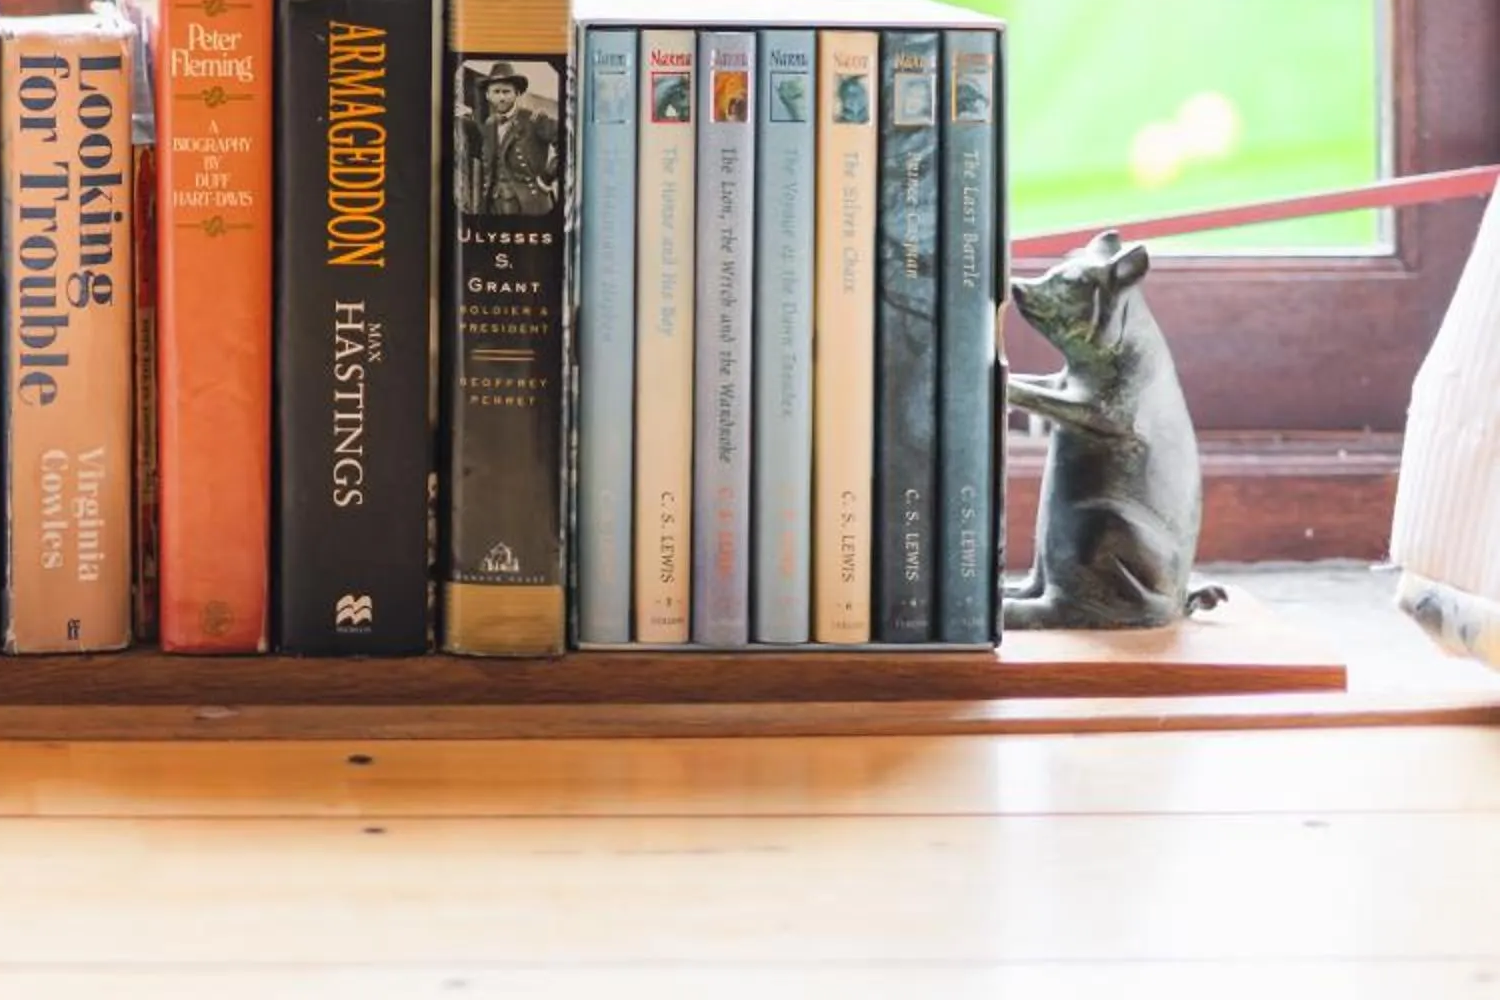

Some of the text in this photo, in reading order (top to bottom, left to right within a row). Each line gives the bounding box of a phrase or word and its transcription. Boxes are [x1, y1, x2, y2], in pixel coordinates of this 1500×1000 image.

[187, 22, 242, 51] Peter
[171, 48, 254, 83] Fleming
[209, 119, 219, 135] A
[172, 136, 251, 152] BIOGRAPHY
[327, 20, 388, 268] ARMAGEDDON
[203, 154, 220, 171] BY
[720, 147, 739, 174] The
[963, 150, 980, 179] The
[66, 54, 123, 309] Looking
[195, 173, 231, 188] DUFF
[173, 190, 253, 208] HART-DAVIS
[963, 186, 980, 224] Last
[18, 53, 71, 407] for Trouble
[495, 252, 514, 270] S.
[367, 322, 382, 363] MAX
[459, 323, 549, 334] PRESIDENT
[720, 313, 738, 343] and
[332, 299, 366, 507] HASTINGS
[40, 449, 70, 571] Cowles
[660, 490, 675, 507] C.
[841, 490, 856, 505] C.
[905, 488, 920, 504] C.
[69, 446, 106, 583] Virginia
[660, 512, 675, 529] S.
[841, 511, 856, 528] S.
[905, 510, 920, 527] S.
[961, 507, 976, 523] S.
[660, 535, 675, 584] LEWIS
[841, 534, 856, 584] LEWIS
[905, 532, 920, 582] LEWIS
[960, 529, 976, 578] LEWIS
